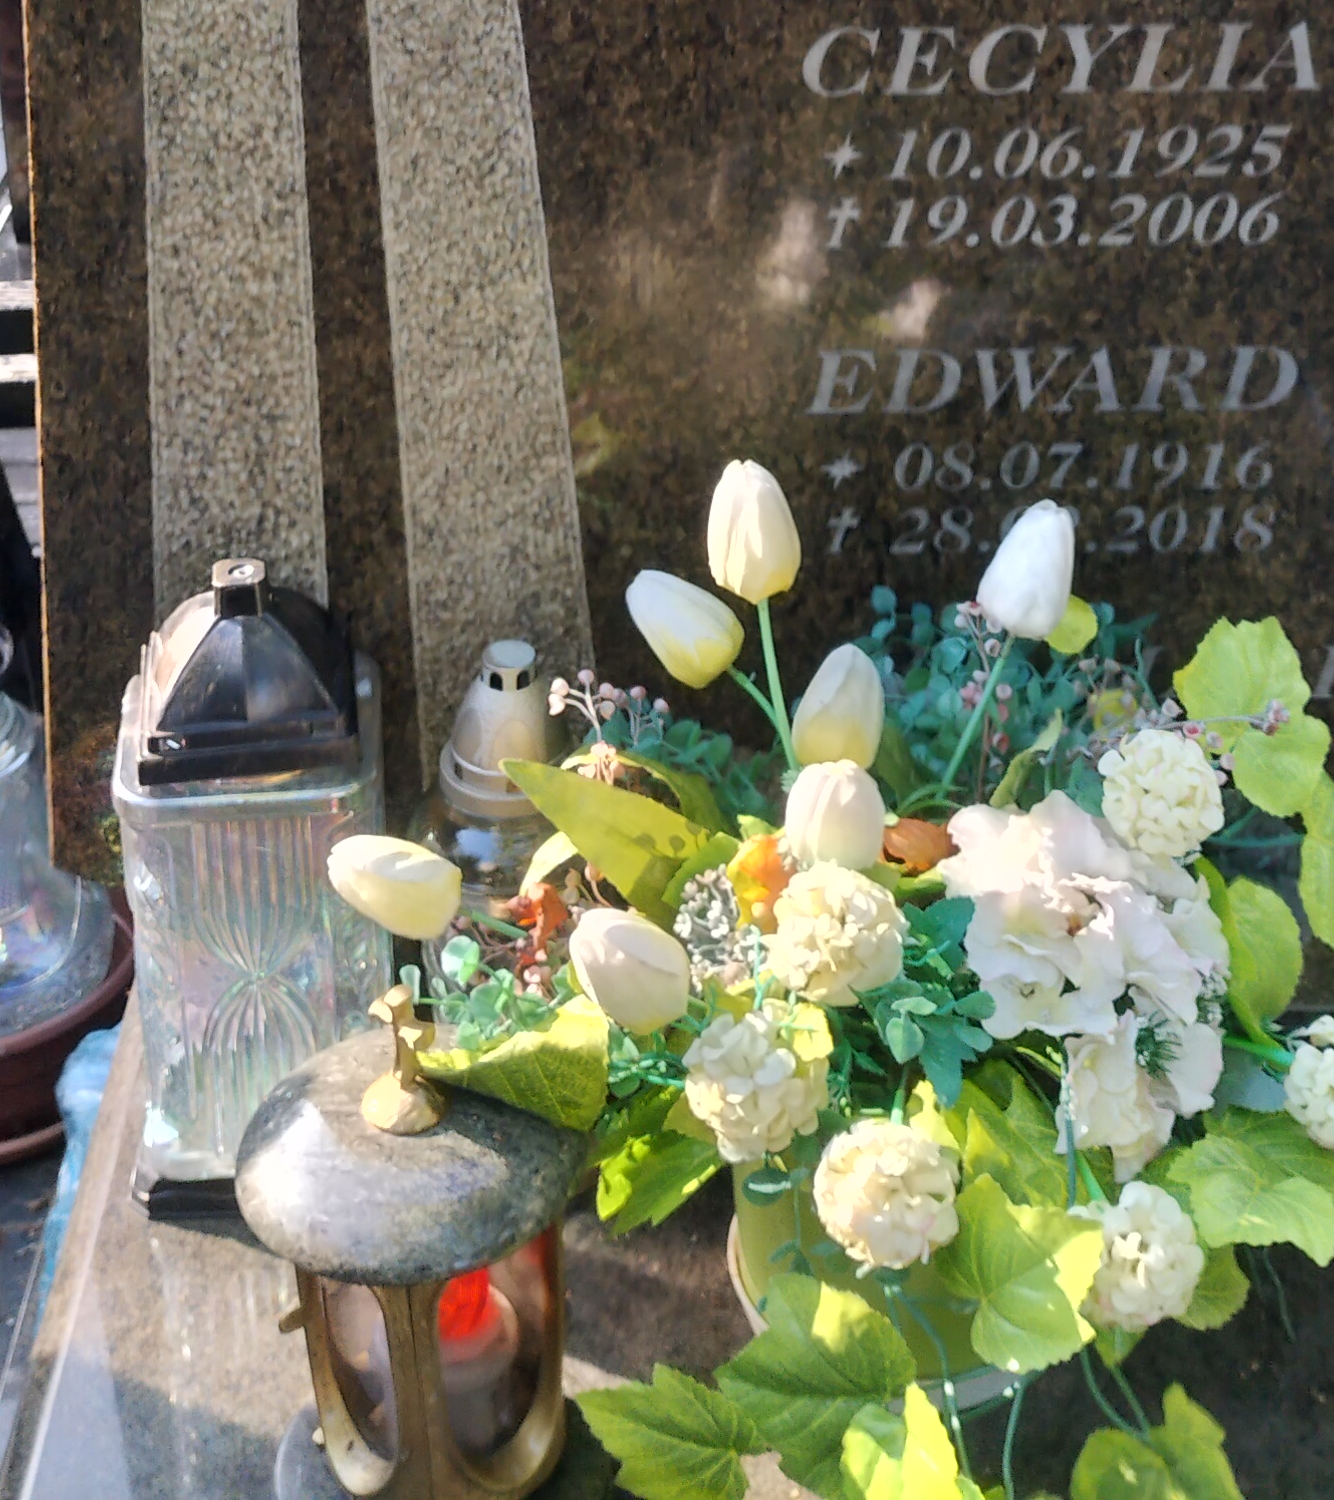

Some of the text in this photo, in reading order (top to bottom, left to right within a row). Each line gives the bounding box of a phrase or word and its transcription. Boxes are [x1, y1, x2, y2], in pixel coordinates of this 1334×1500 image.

[800, 21, 1322, 98] CECYLIA
[886, 122, 1293, 181] 10.06.1925
[882, 191, 1285, 249] 19.03.2006
[803, 344, 1300, 417] EDWARD
[892, 440, 1274, 492] 08.07.1916
[888, 503, 1277, 555] 28..2018
